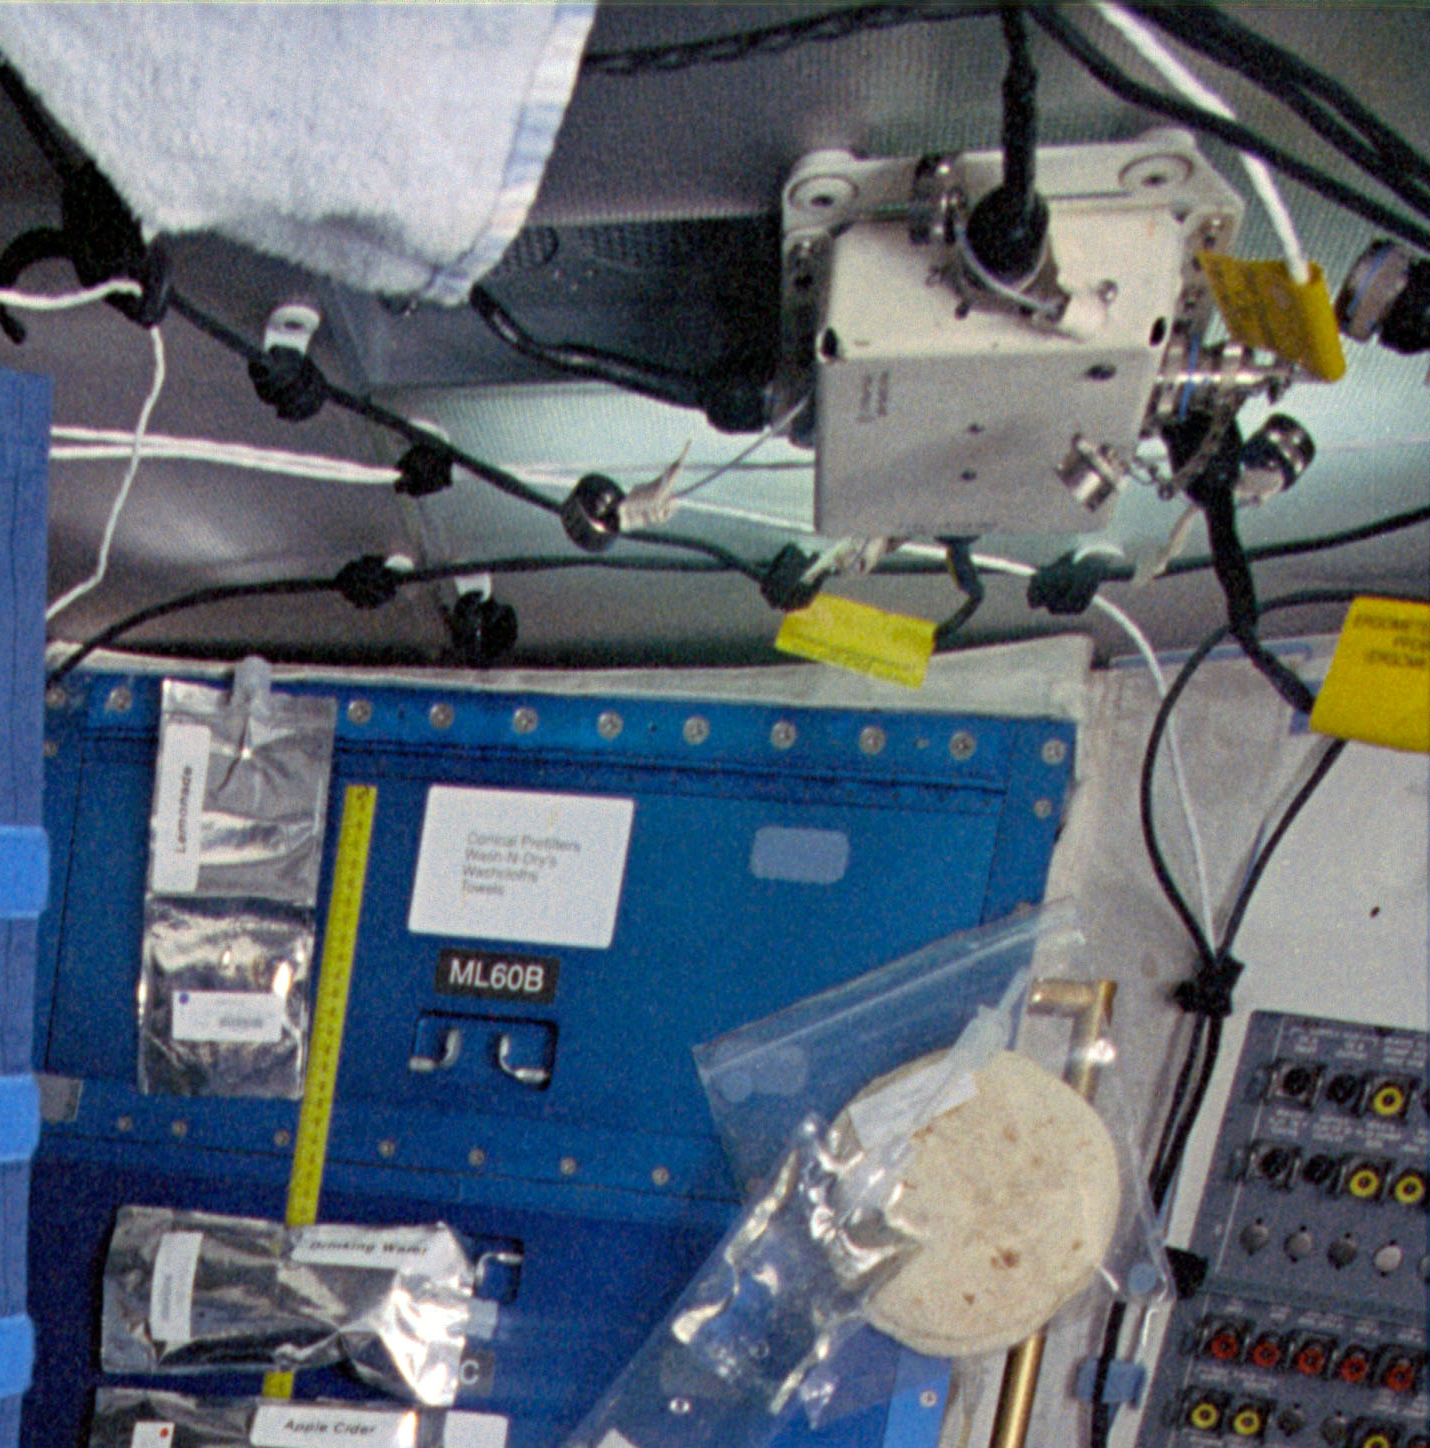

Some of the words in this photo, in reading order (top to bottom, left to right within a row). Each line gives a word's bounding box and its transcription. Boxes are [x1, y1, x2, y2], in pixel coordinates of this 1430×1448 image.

[176, 765, 192, 854] Lemonade
[449, 957, 544, 992] ML60B
[310, 1242, 374, 1255] Drinking
[284, 1418, 327, 1434] Apple
[334, 1421, 377, 1436] Cider
